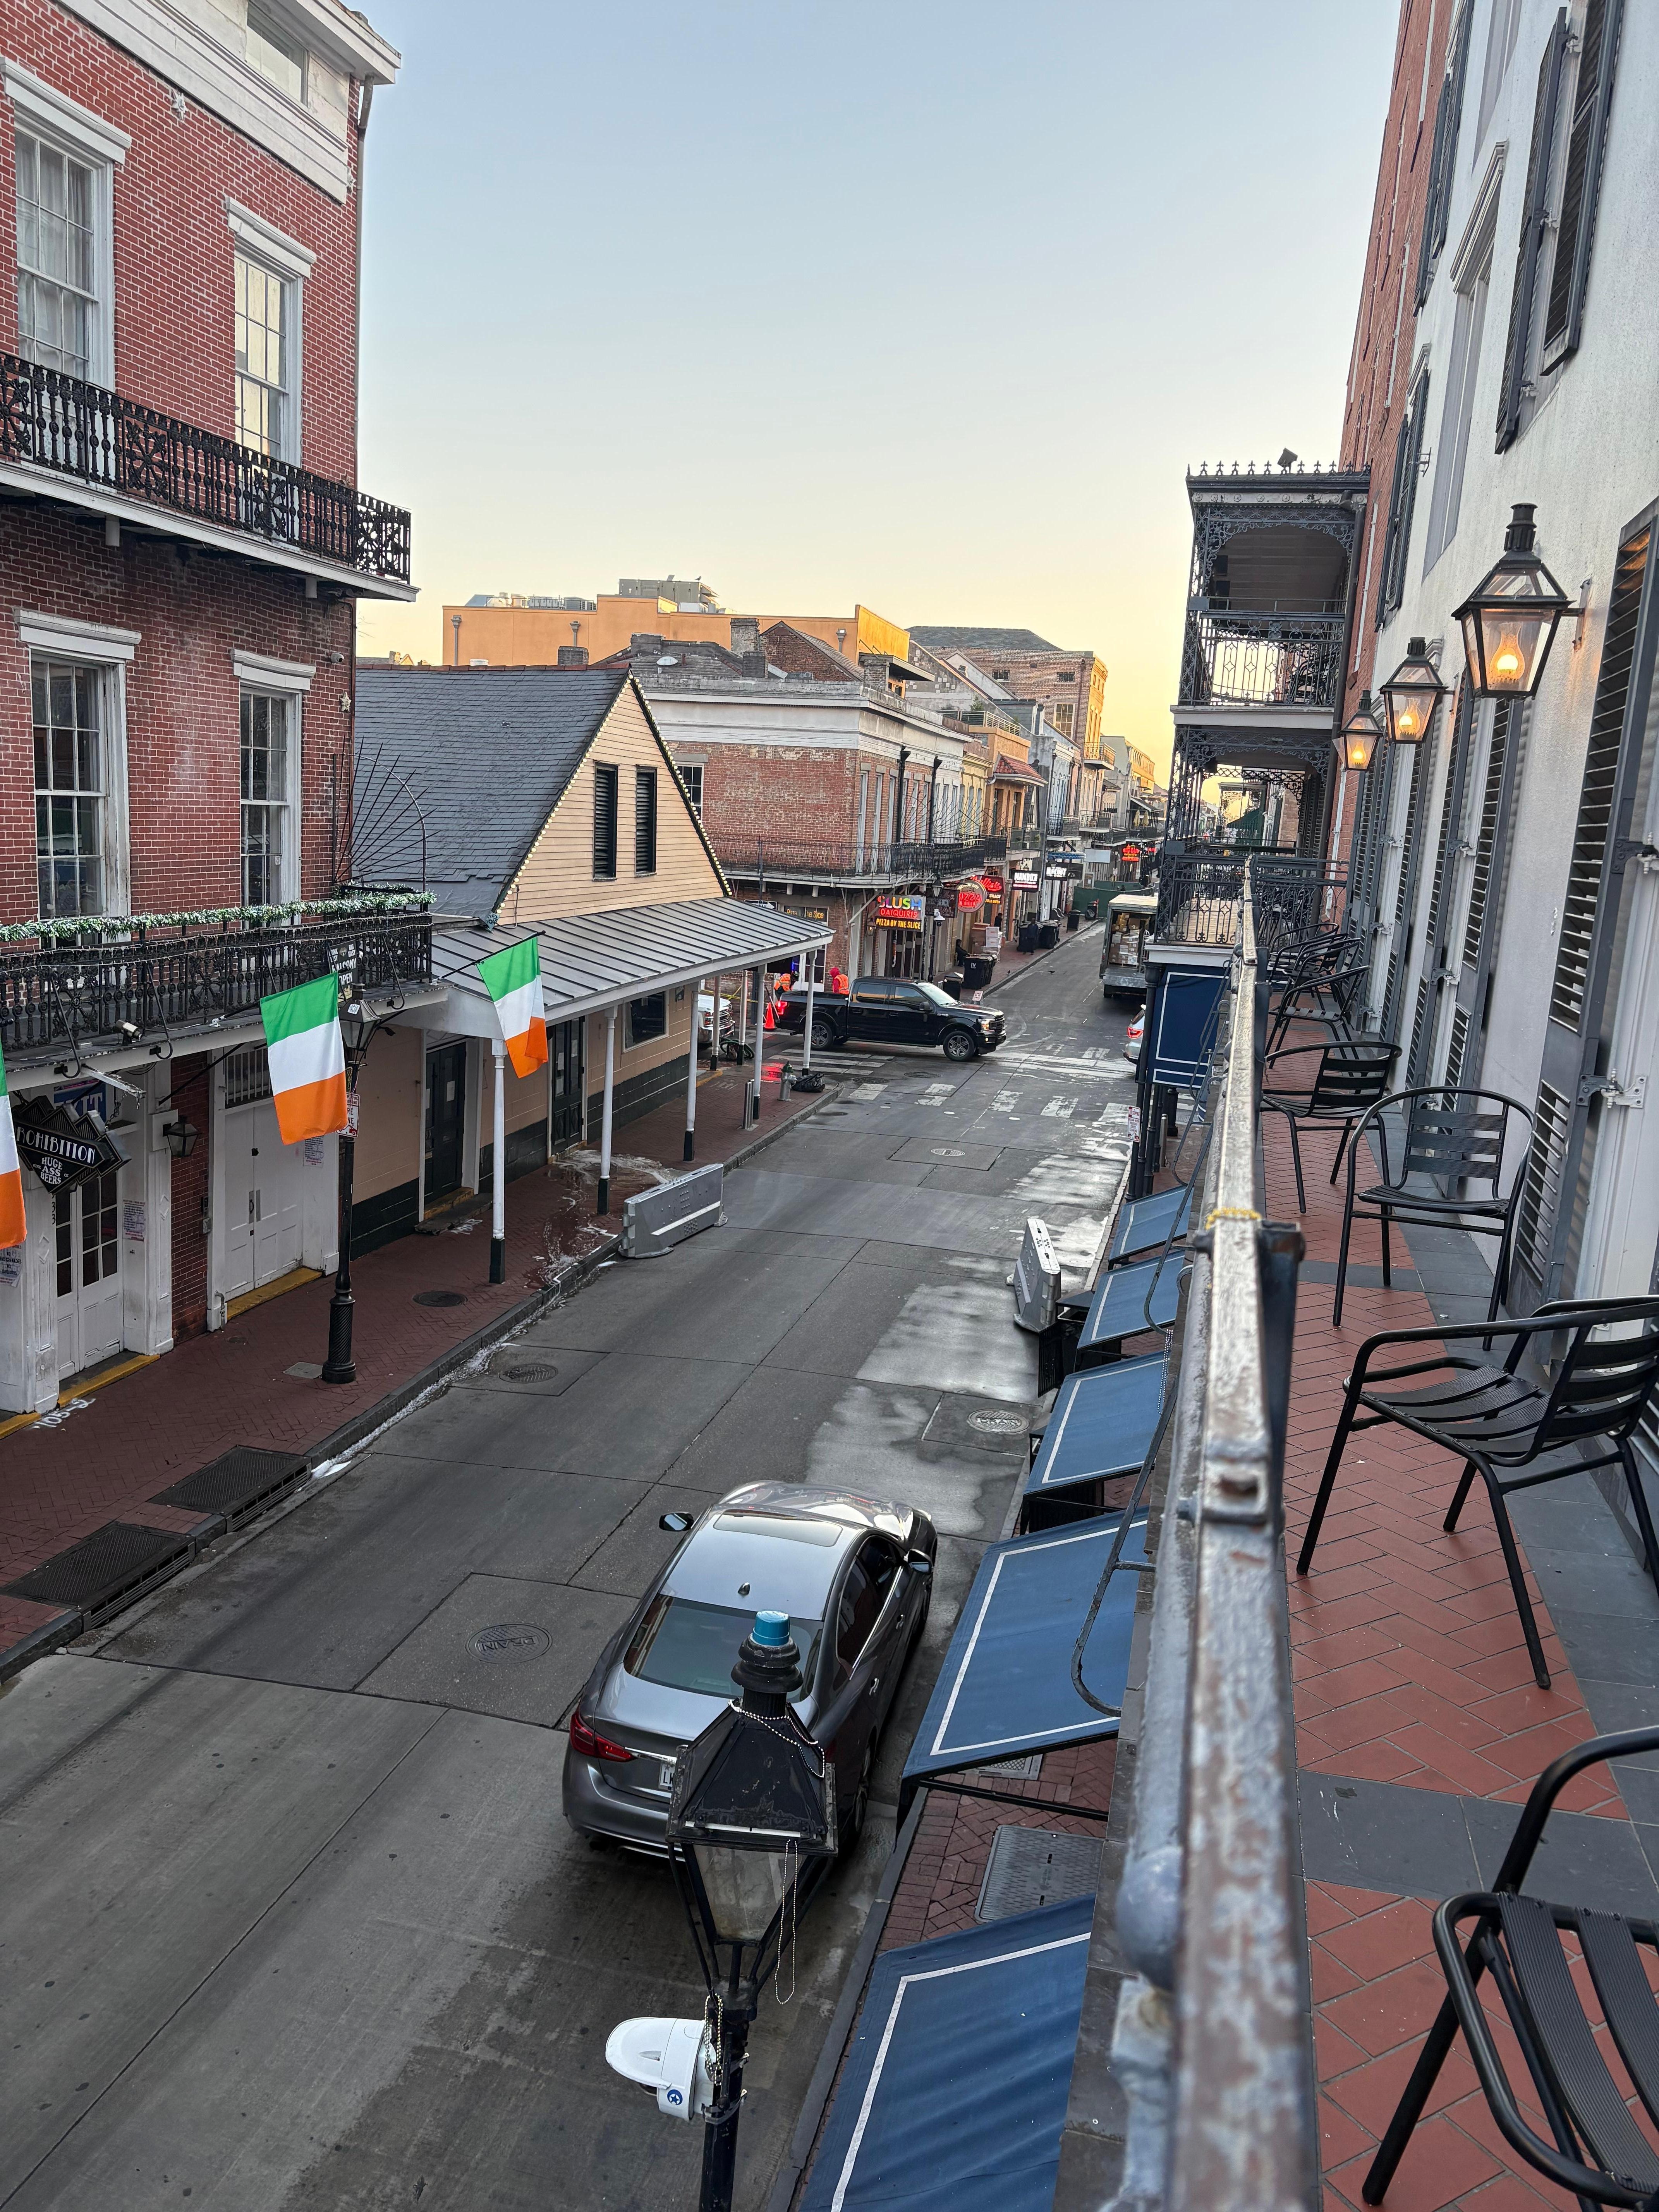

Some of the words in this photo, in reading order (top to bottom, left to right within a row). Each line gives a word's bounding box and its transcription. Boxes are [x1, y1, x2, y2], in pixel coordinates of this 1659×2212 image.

[877, 895, 922, 910] SLUSH
[880, 908, 918, 918] DAIQUIRIS
[876, 918, 890, 926] PIZZA
[907, 921, 921, 929] SLICE
[17, 1127, 95, 1164] ROHIBITION
[41, 1157, 62, 1170] HUGE
[42, 1165, 61, 1177] ASS
[40, 1172, 62, 1185] BEERS
